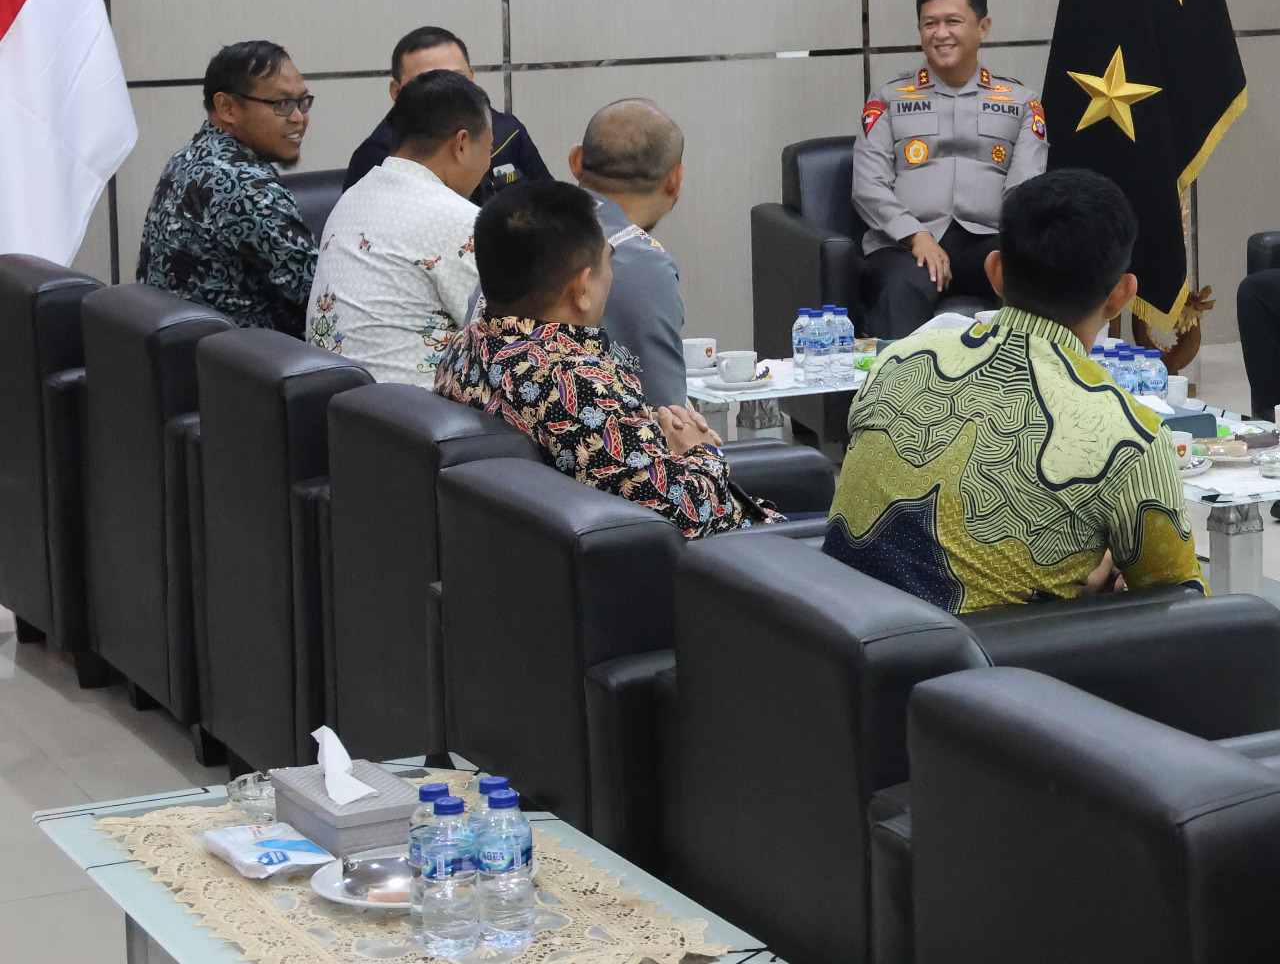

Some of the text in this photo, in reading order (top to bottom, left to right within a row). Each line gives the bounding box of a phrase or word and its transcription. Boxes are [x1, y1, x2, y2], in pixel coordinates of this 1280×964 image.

[896, 100, 932, 113] IWAN
[982, 102, 1019, 116] POLRI
[481, 850, 506, 863] AQUA
